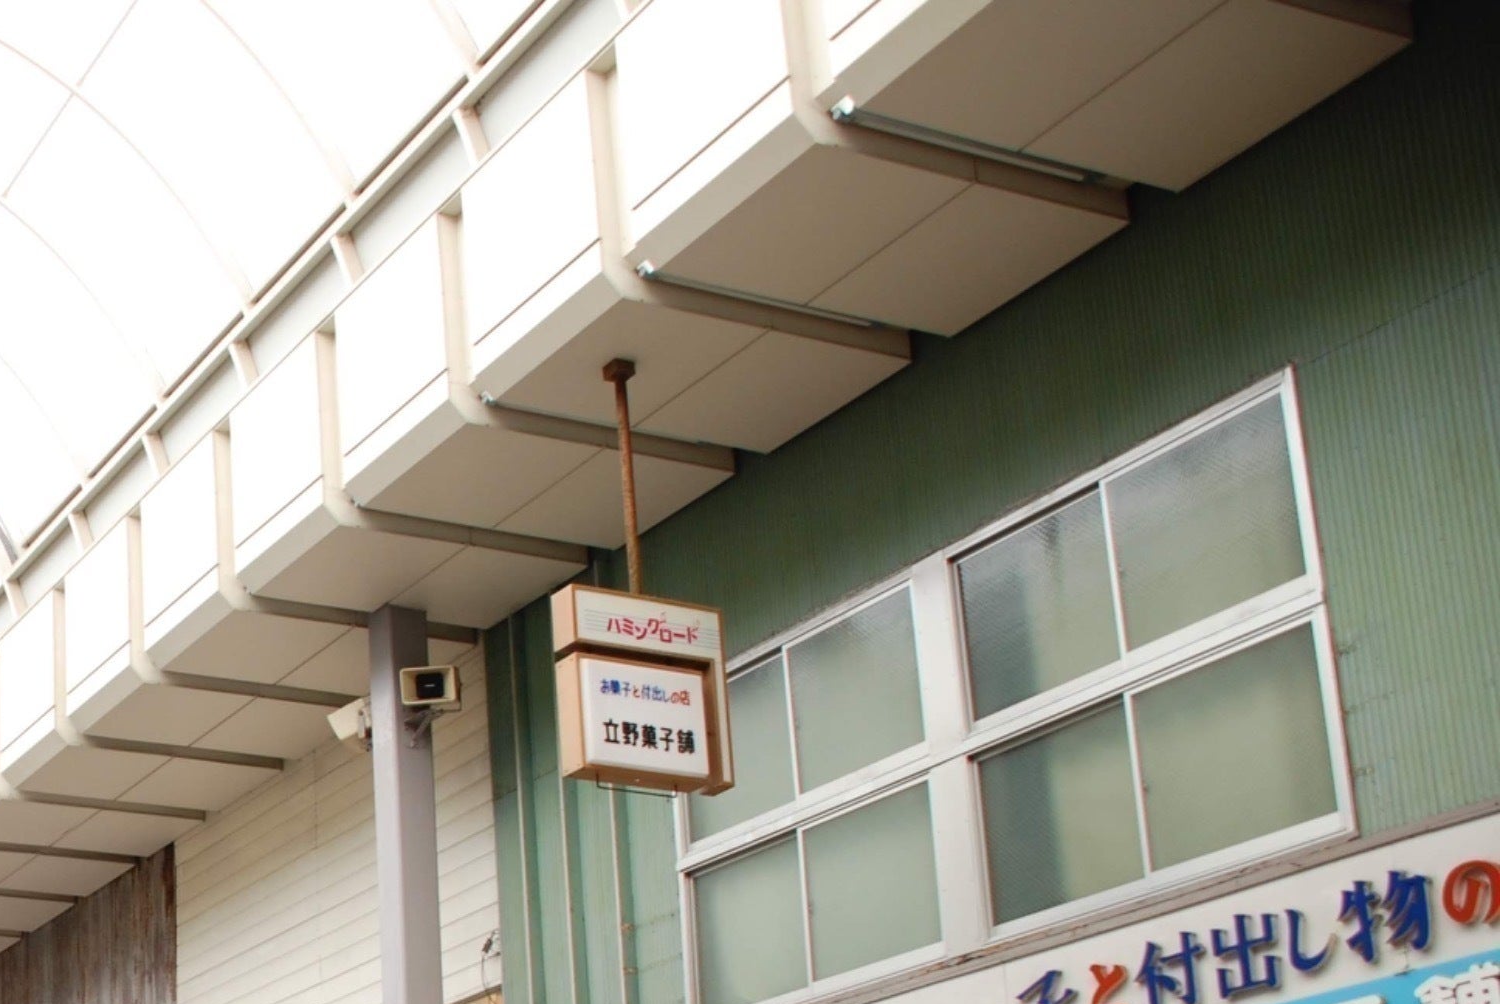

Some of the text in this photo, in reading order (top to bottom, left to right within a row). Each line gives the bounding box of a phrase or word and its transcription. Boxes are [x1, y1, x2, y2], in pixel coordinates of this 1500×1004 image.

[606, 616, 699, 643] ハミングロード
[603, 718, 696, 755] 立野菓子舗
